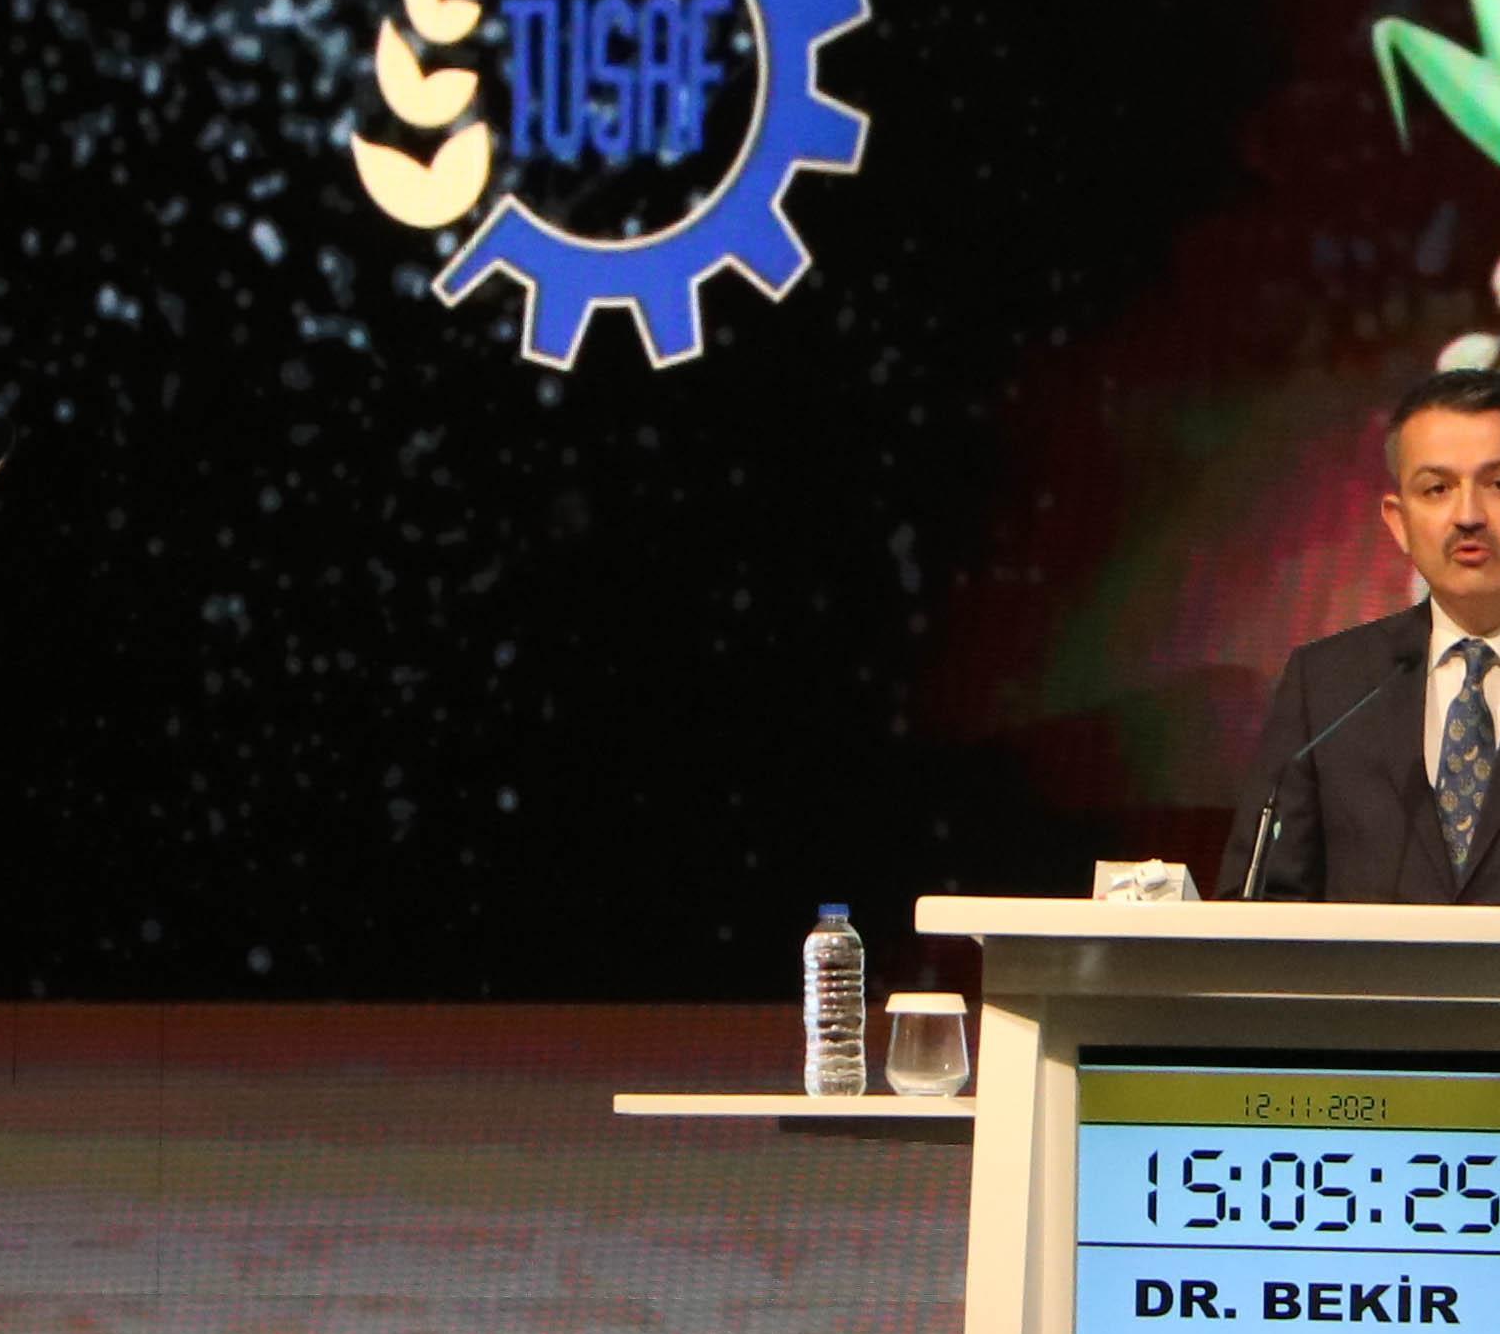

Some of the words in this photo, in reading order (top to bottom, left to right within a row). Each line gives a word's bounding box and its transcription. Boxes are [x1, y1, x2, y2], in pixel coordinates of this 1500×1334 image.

[1147, 1149, 1500, 1234] 15:05:25
[1134, 1278, 1238, 1320] DR.
[1262, 1274, 1461, 1325] BEKİR
